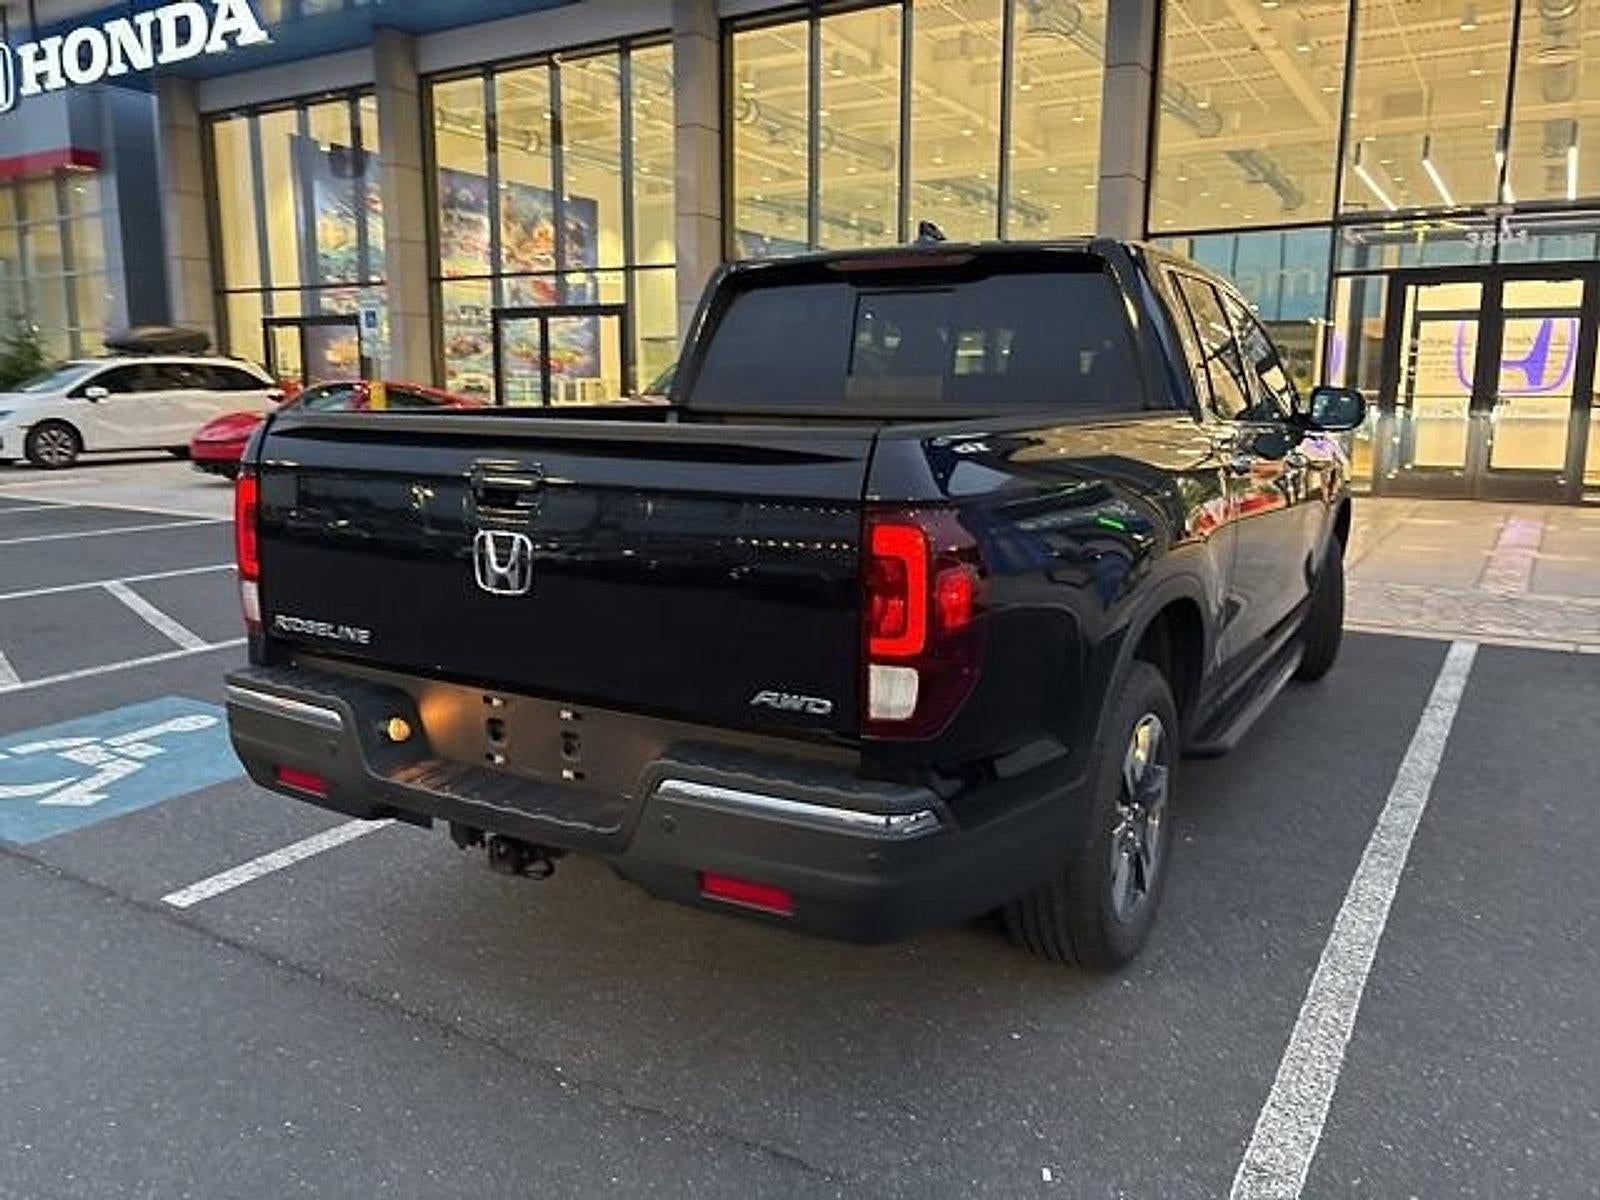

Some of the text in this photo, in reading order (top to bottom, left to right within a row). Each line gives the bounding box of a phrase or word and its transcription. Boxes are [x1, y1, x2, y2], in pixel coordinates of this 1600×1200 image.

[16, 0, 274, 96] HONDA
[274, 614, 371, 644] RIDGELINE
[750, 690, 832, 714] AWD
